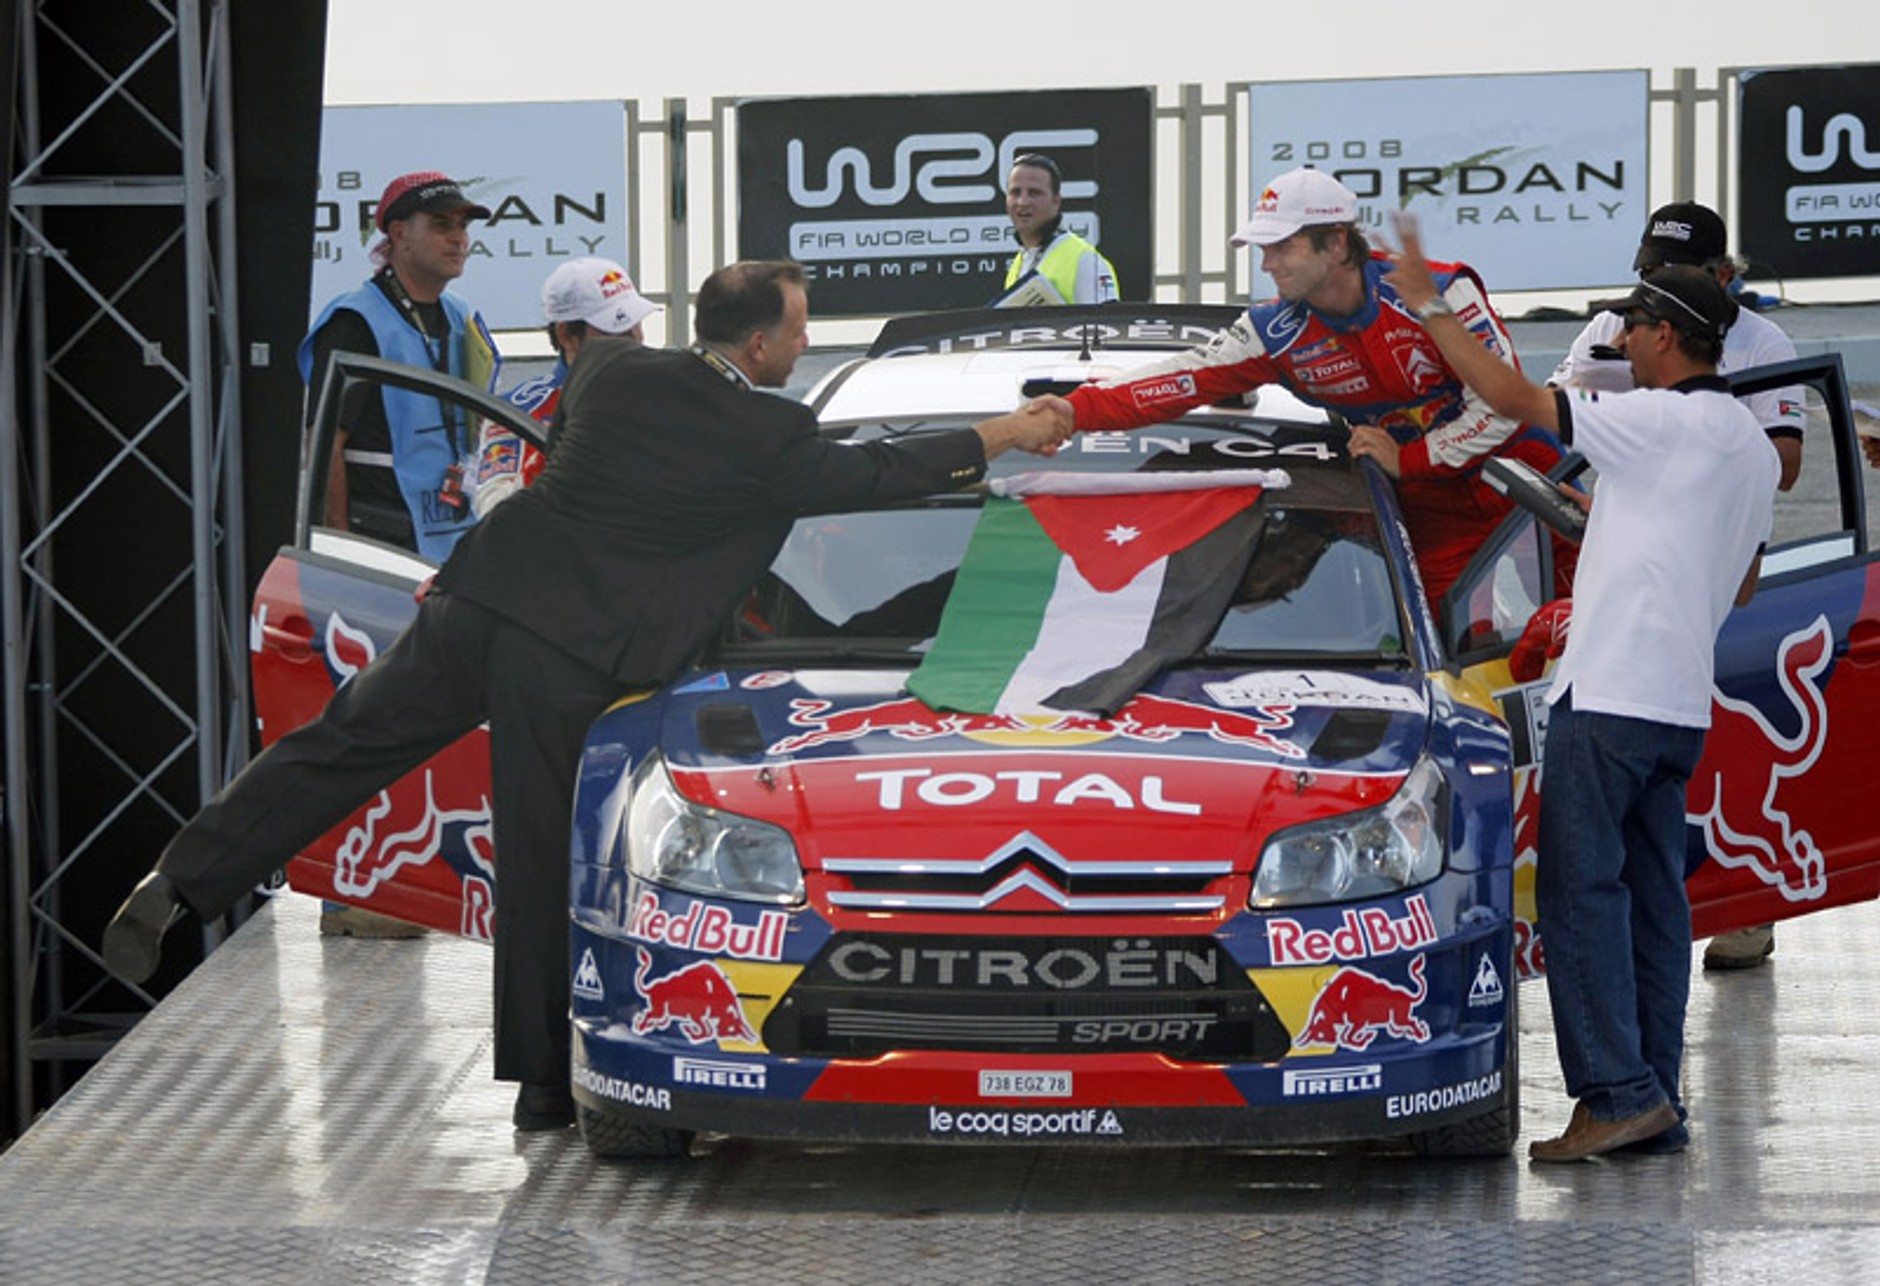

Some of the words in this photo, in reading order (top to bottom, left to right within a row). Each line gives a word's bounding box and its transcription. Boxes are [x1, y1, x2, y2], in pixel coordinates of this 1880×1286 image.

[1272, 140, 1402, 161] 2008
[1786, 104, 1880, 172] W
[787, 128, 1099, 208] WRC
[1303, 160, 1624, 198] ORDAN
[1456, 202, 1624, 224] RALLY
[1795, 194, 1839, 211] FIA
[467, 235, 605, 257] ALLY
[799, 232, 845, 248] FIA
[855, 228, 970, 247] WORLD
[1212, 439, 1338, 460] C4
[855, 769, 1201, 815] TOTAL
[461, 874, 497, 945] R
[627, 891, 703, 949] Red
[693, 905, 788, 961] Bull
[1266, 909, 1367, 966] Red
[1359, 893, 1438, 957] Bull
[828, 939, 1217, 988] CITROËN
[1072, 1020, 1218, 1043] SPORT
[673, 1056, 766, 1089] PIRELLI
[986, 1076, 1011, 1091] 738
[1014, 1077, 1044, 1091] EGZ
[1049, 1077, 1067, 1091] 78
[1283, 1064, 1382, 1096] PIRELLI
[1386, 1071, 1501, 1118] EURODATACAR
[930, 1106, 953, 1131] le
[956, 1112, 1009, 1136] coq
[1012, 1109, 1096, 1136] sportif
